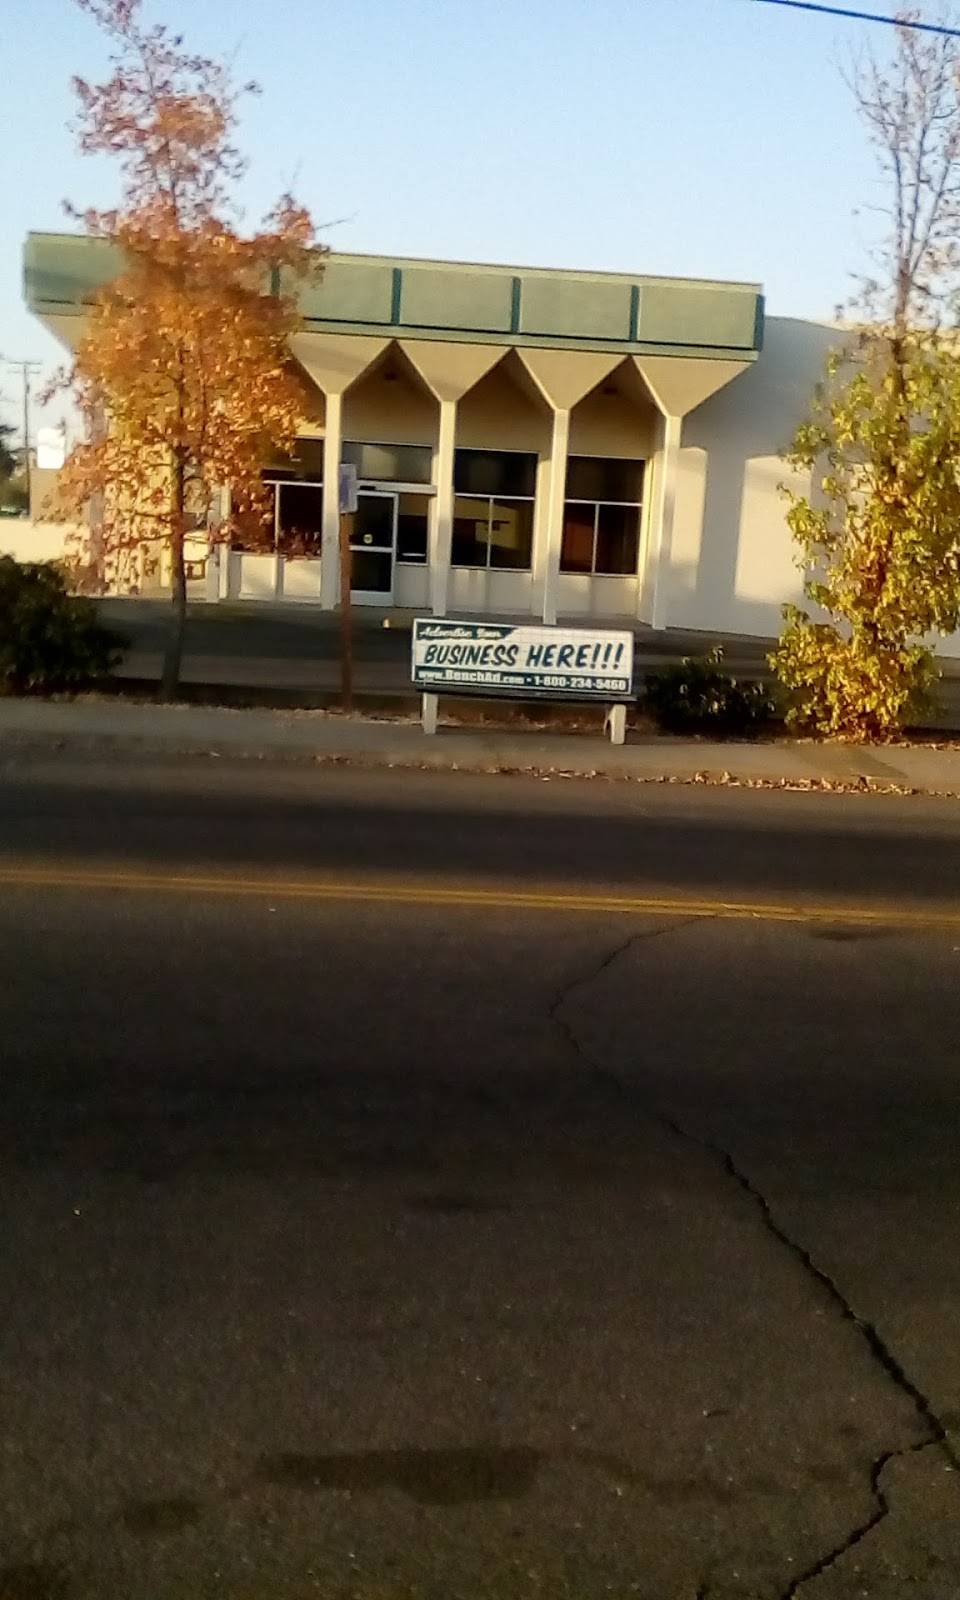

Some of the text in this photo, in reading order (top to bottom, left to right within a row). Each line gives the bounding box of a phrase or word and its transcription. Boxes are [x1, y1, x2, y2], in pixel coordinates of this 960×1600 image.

[424, 643, 624, 669] BUSINESS HERE!!!
[418, 669, 525, 685] www.BenchAd.com
